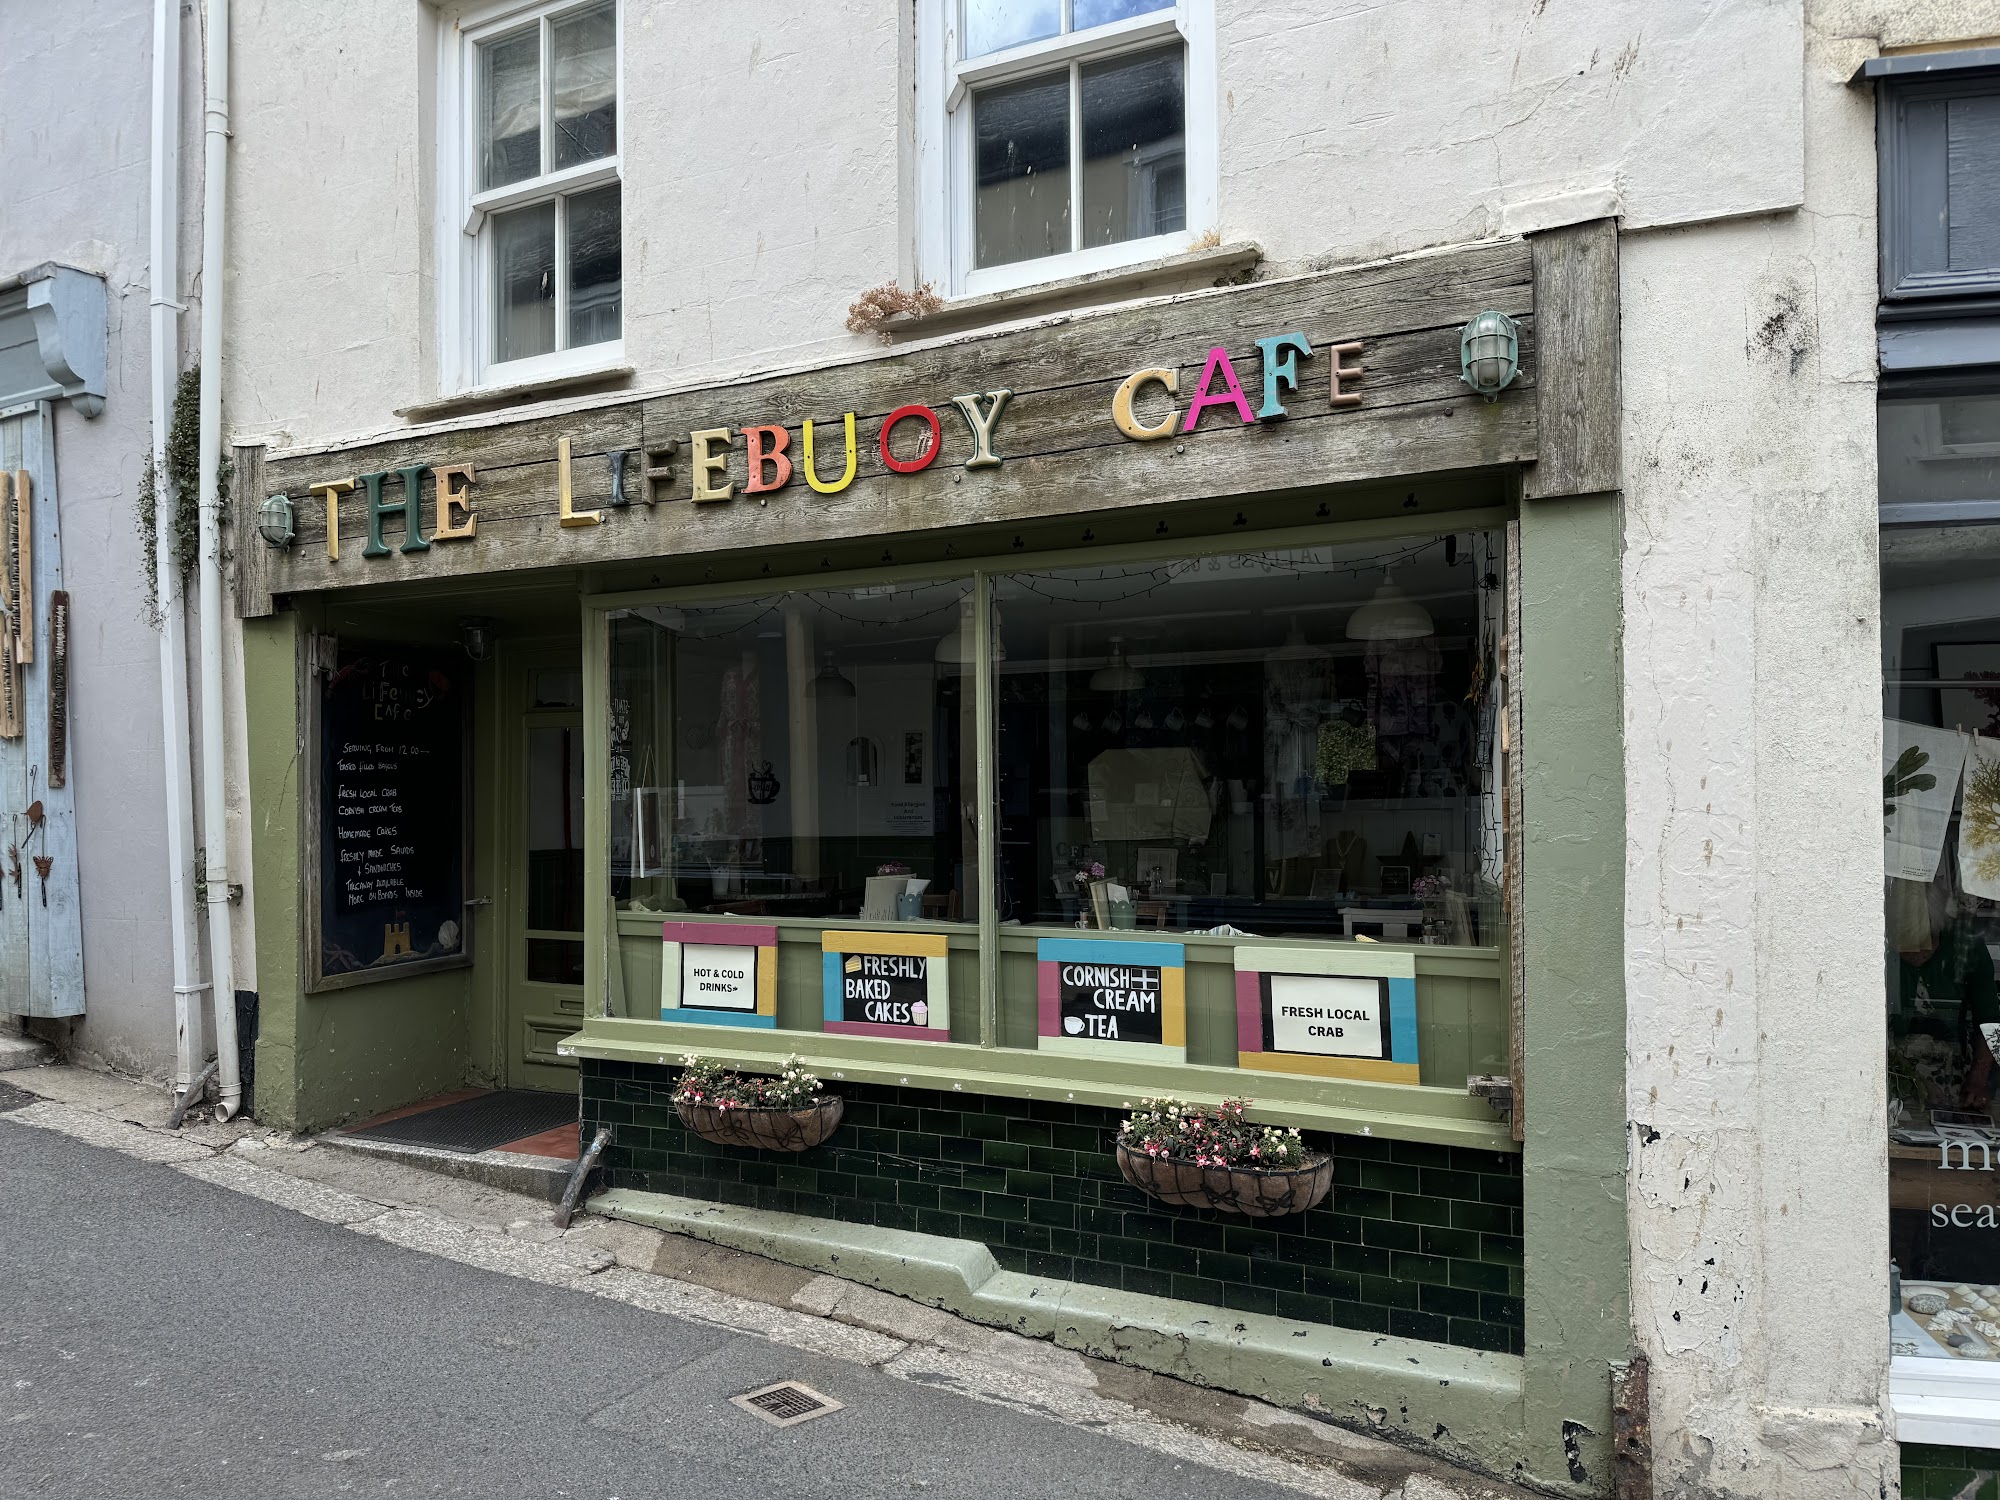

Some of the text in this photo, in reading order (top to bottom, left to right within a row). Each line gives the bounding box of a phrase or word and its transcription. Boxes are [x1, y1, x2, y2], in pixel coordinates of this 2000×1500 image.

[309, 331, 1364, 562] THE LIFEBUOY CAFE
[375, 744, 393, 753] FROM
[693, 968, 744, 979] HOT & COLD
[864, 955, 927, 979] FRESHLY
[1062, 965, 1131, 990] CORNISH
[699, 982, 732, 992] DRINKS
[845, 978, 891, 1000] BAKED
[865, 1000, 911, 1024] CAKES
[1093, 989, 1156, 1013] CREAM
[1281, 1006, 1370, 1021] FRESH LOCAL
[1085, 1013, 1119, 1039] TEA
[1308, 1025, 1344, 1038] CRAB
[1931, 1203, 2000, 1228] sea
